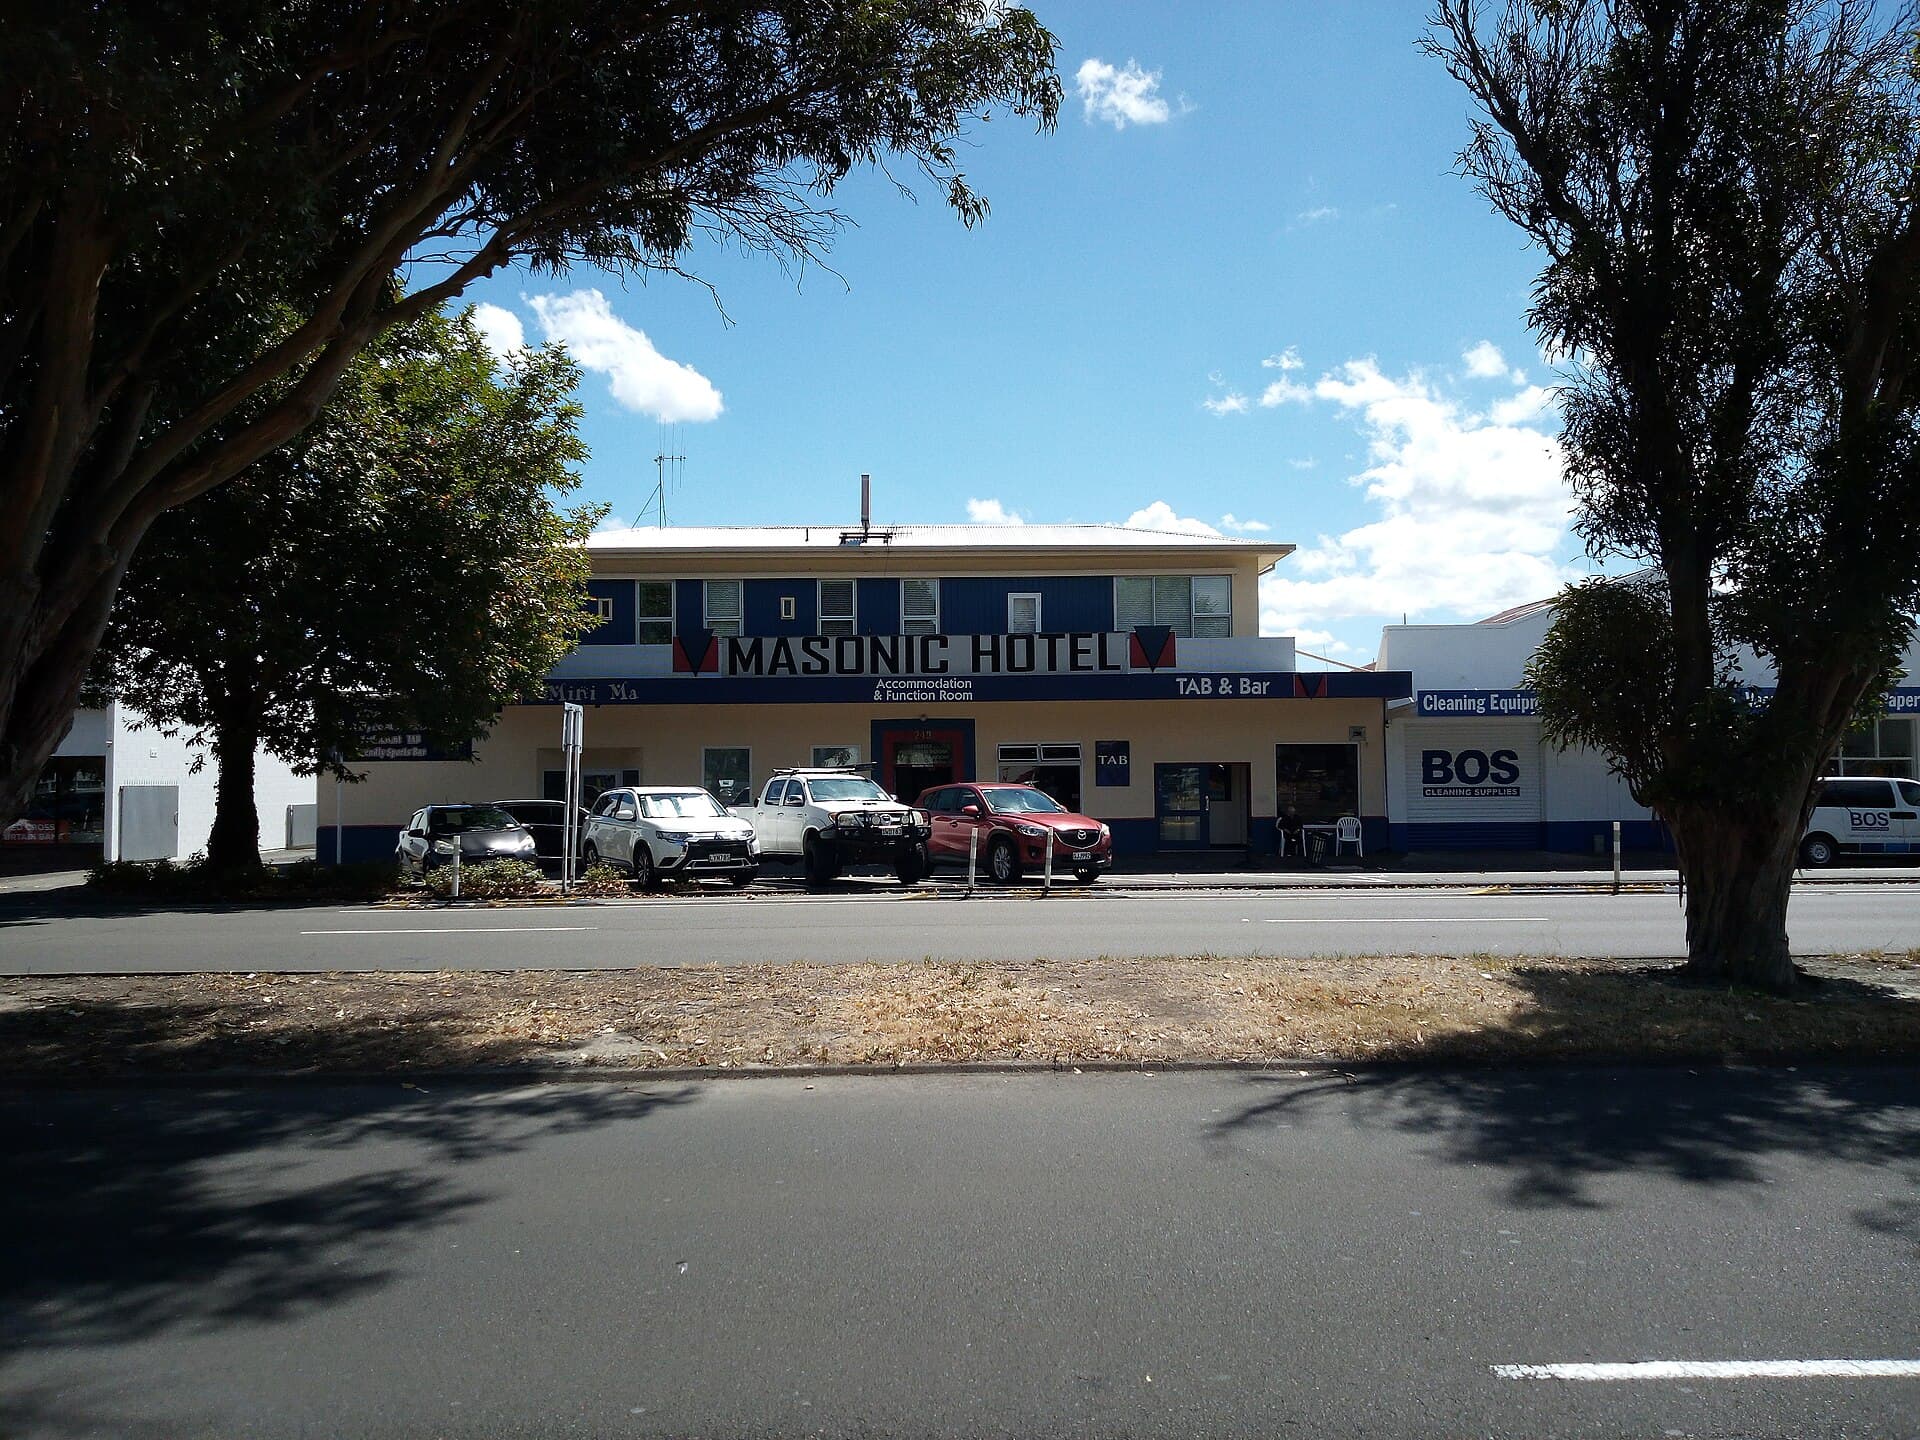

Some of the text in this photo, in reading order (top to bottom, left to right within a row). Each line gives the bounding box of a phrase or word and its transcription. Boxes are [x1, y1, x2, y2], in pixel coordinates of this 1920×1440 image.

[729, 633, 1121, 675] MASONIC HOTEL
[548, 681, 640, 701] Mini Ma
[876, 678, 972, 689] Accommodation
[1176, 677, 1270, 695] TAB & Bar
[873, 690, 973, 701] & Function Room
[1423, 694, 1486, 714] Cleaning
[1097, 755, 1128, 765] TAB
[1422, 749, 1519, 785] BOS
[1424, 788, 1519, 797] CLEANING SUPPLIES
[1851, 812, 1889, 826] BOS
